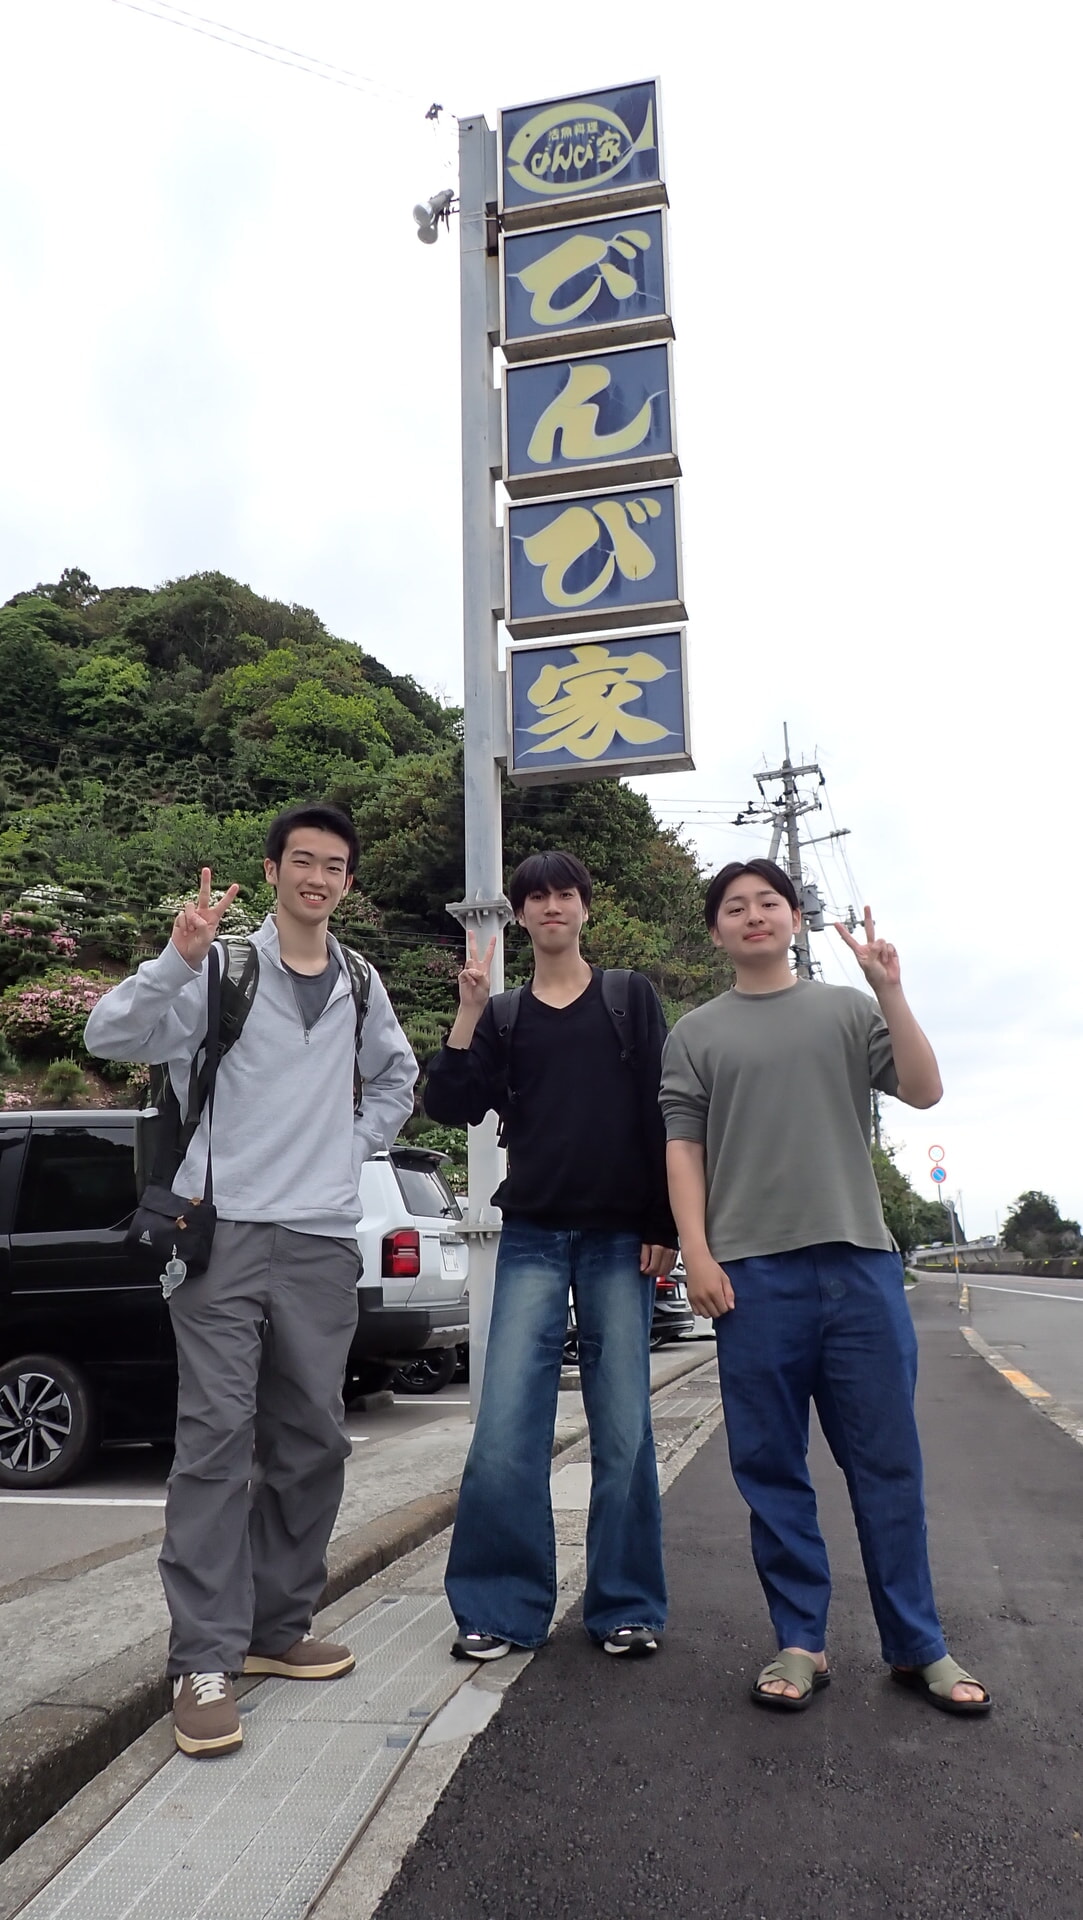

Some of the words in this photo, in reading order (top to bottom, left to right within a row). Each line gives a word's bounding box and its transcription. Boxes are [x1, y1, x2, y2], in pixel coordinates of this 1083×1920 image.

[531, 127, 621, 175] びんび家
[506, 229, 683, 760] びんび家
